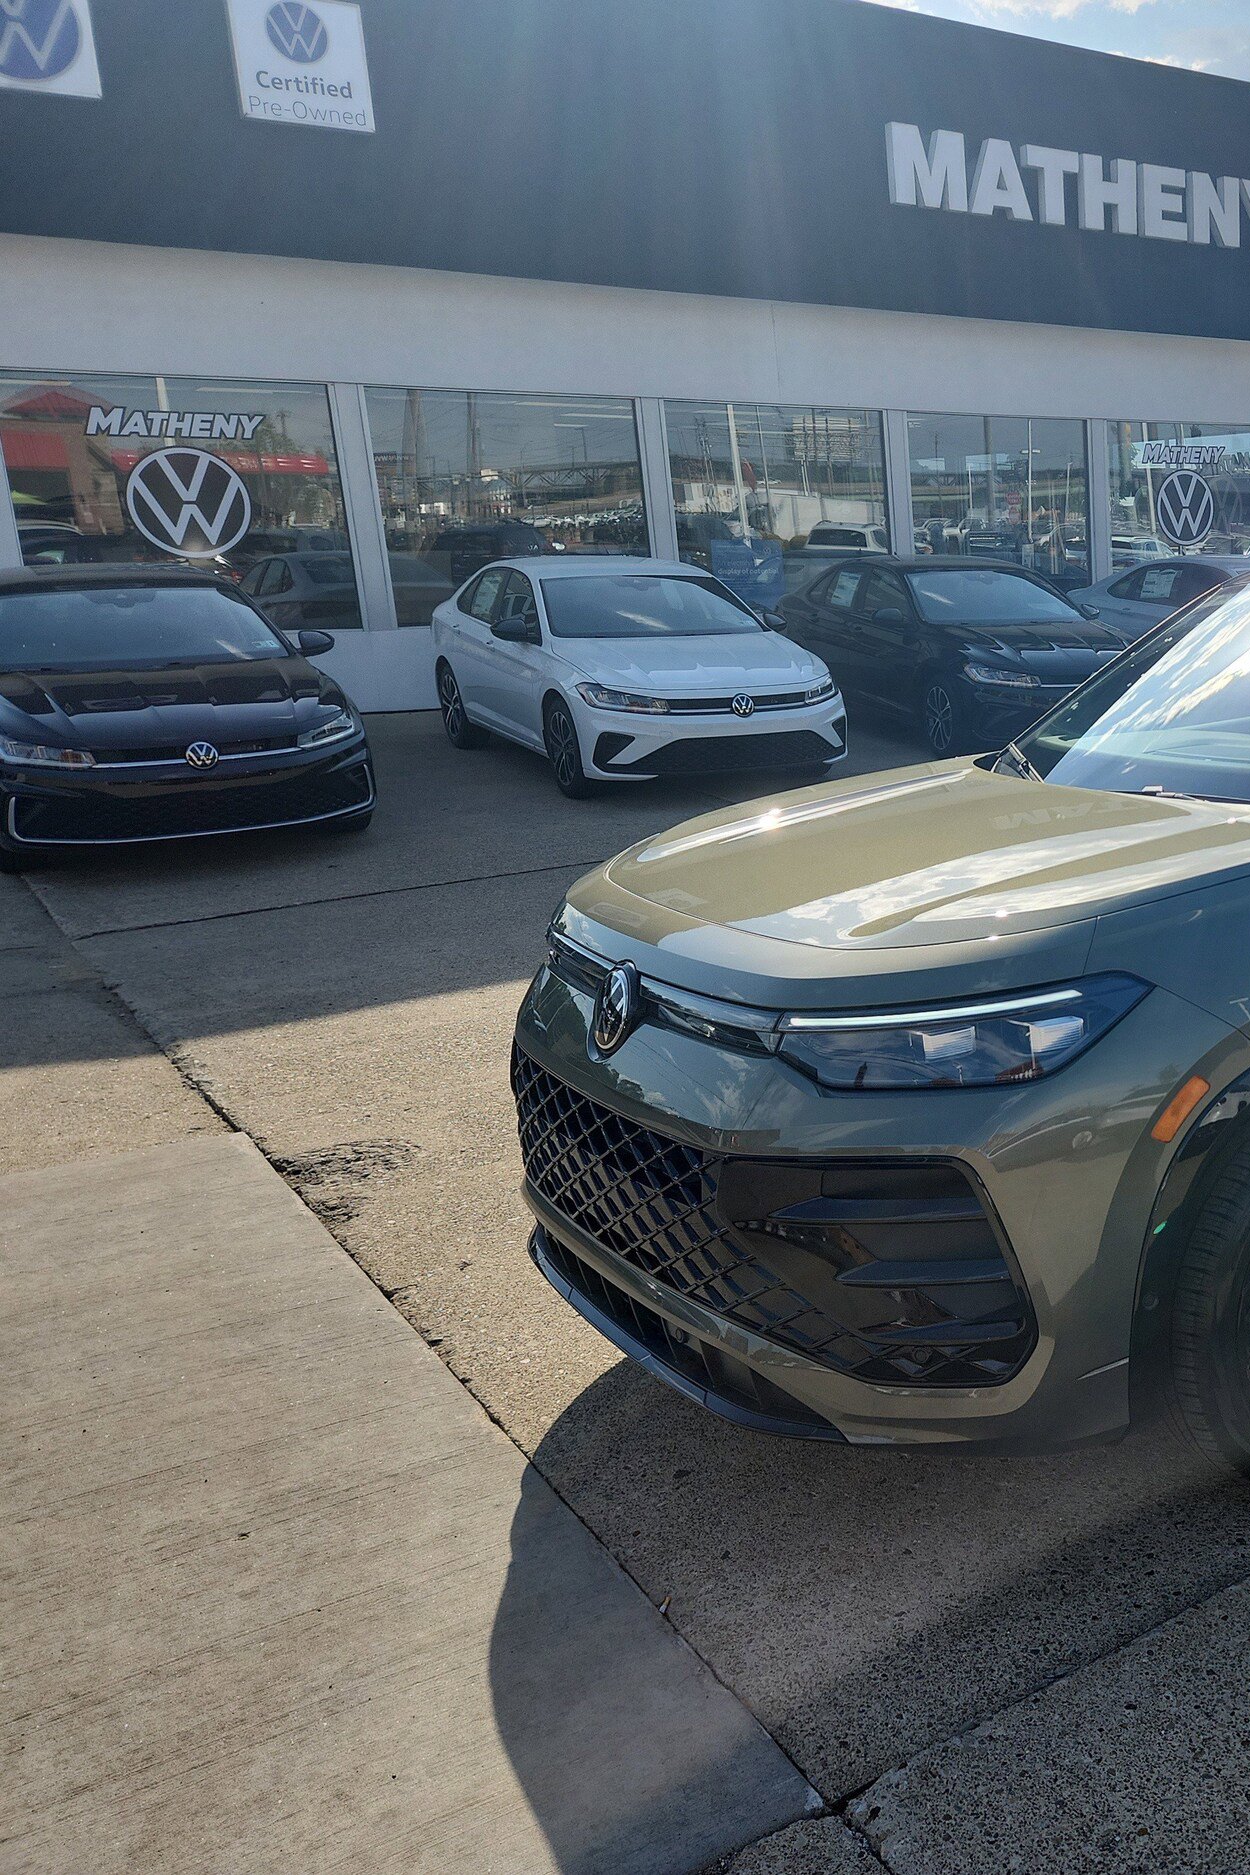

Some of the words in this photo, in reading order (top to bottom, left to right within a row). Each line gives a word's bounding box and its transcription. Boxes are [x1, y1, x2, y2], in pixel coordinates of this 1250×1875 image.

[255, 70, 353, 99] Certified
[248, 95, 367, 127] Pre-Owned
[86, 406, 265, 439] MATHENY
[1142, 443, 1225, 465] MATHENY
[718, 567, 742, 576] display
